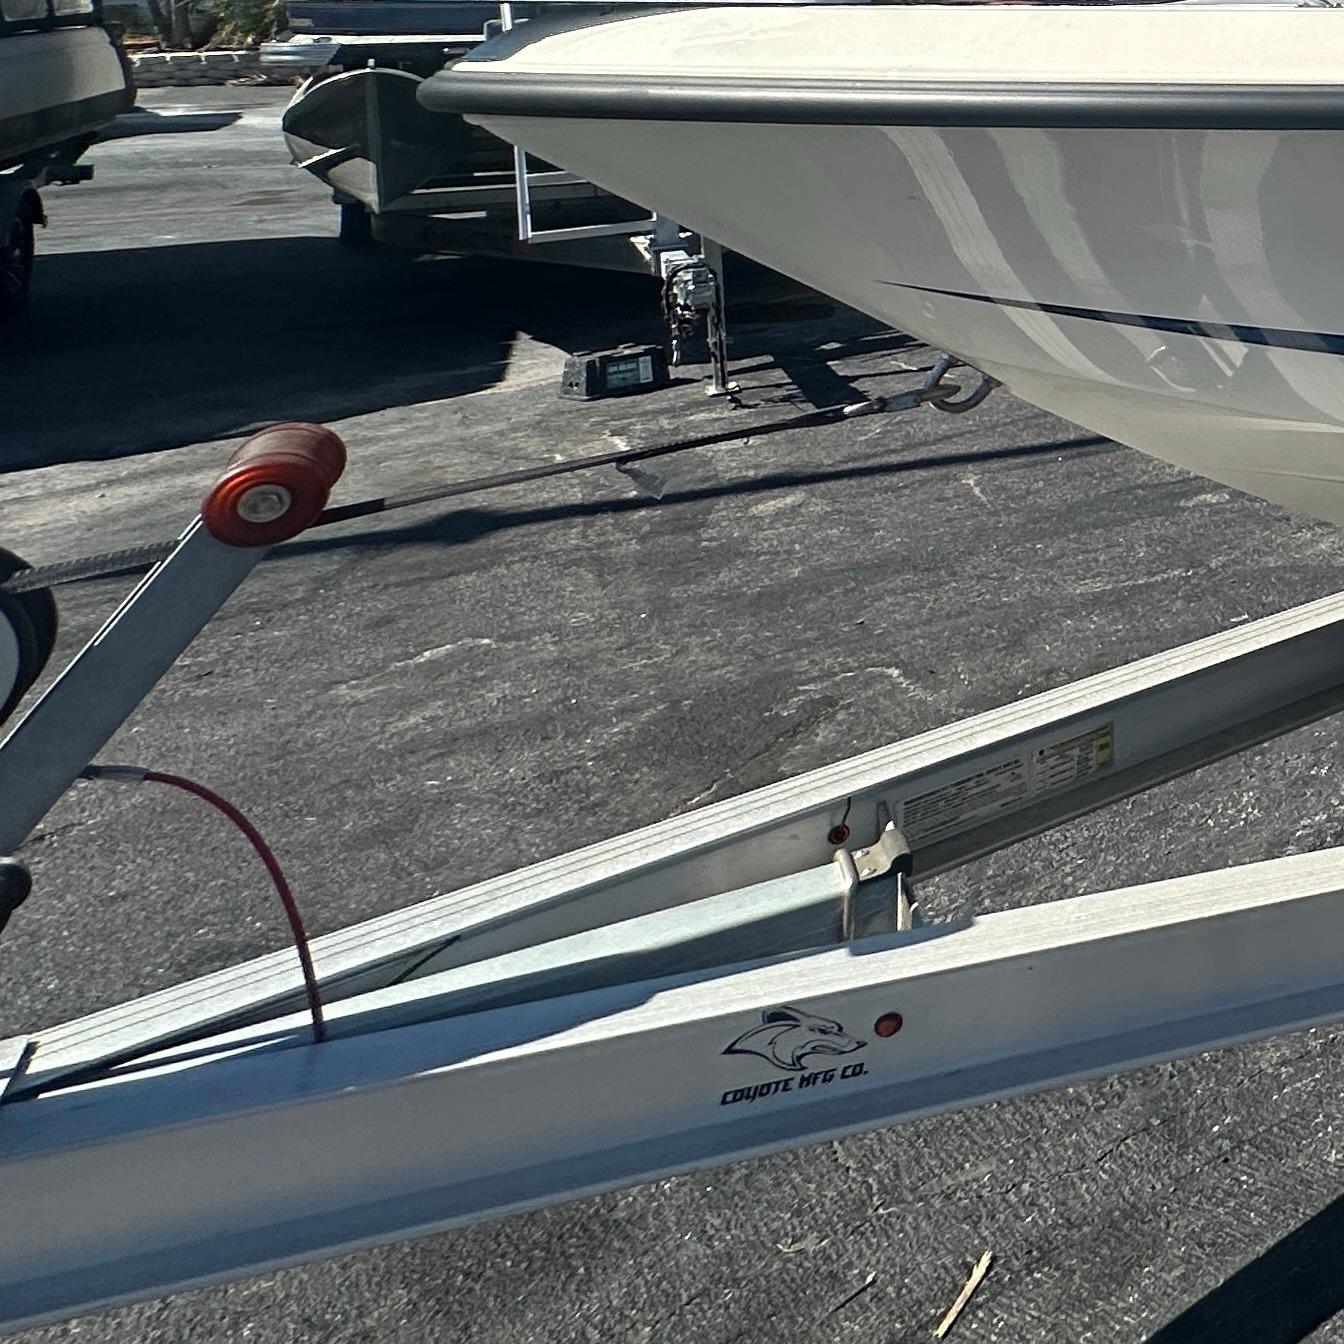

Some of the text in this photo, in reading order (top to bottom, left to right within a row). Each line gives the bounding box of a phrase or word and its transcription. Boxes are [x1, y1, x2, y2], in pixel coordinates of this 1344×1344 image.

[720, 1062, 869, 1106] COYOTE MFG CO.
